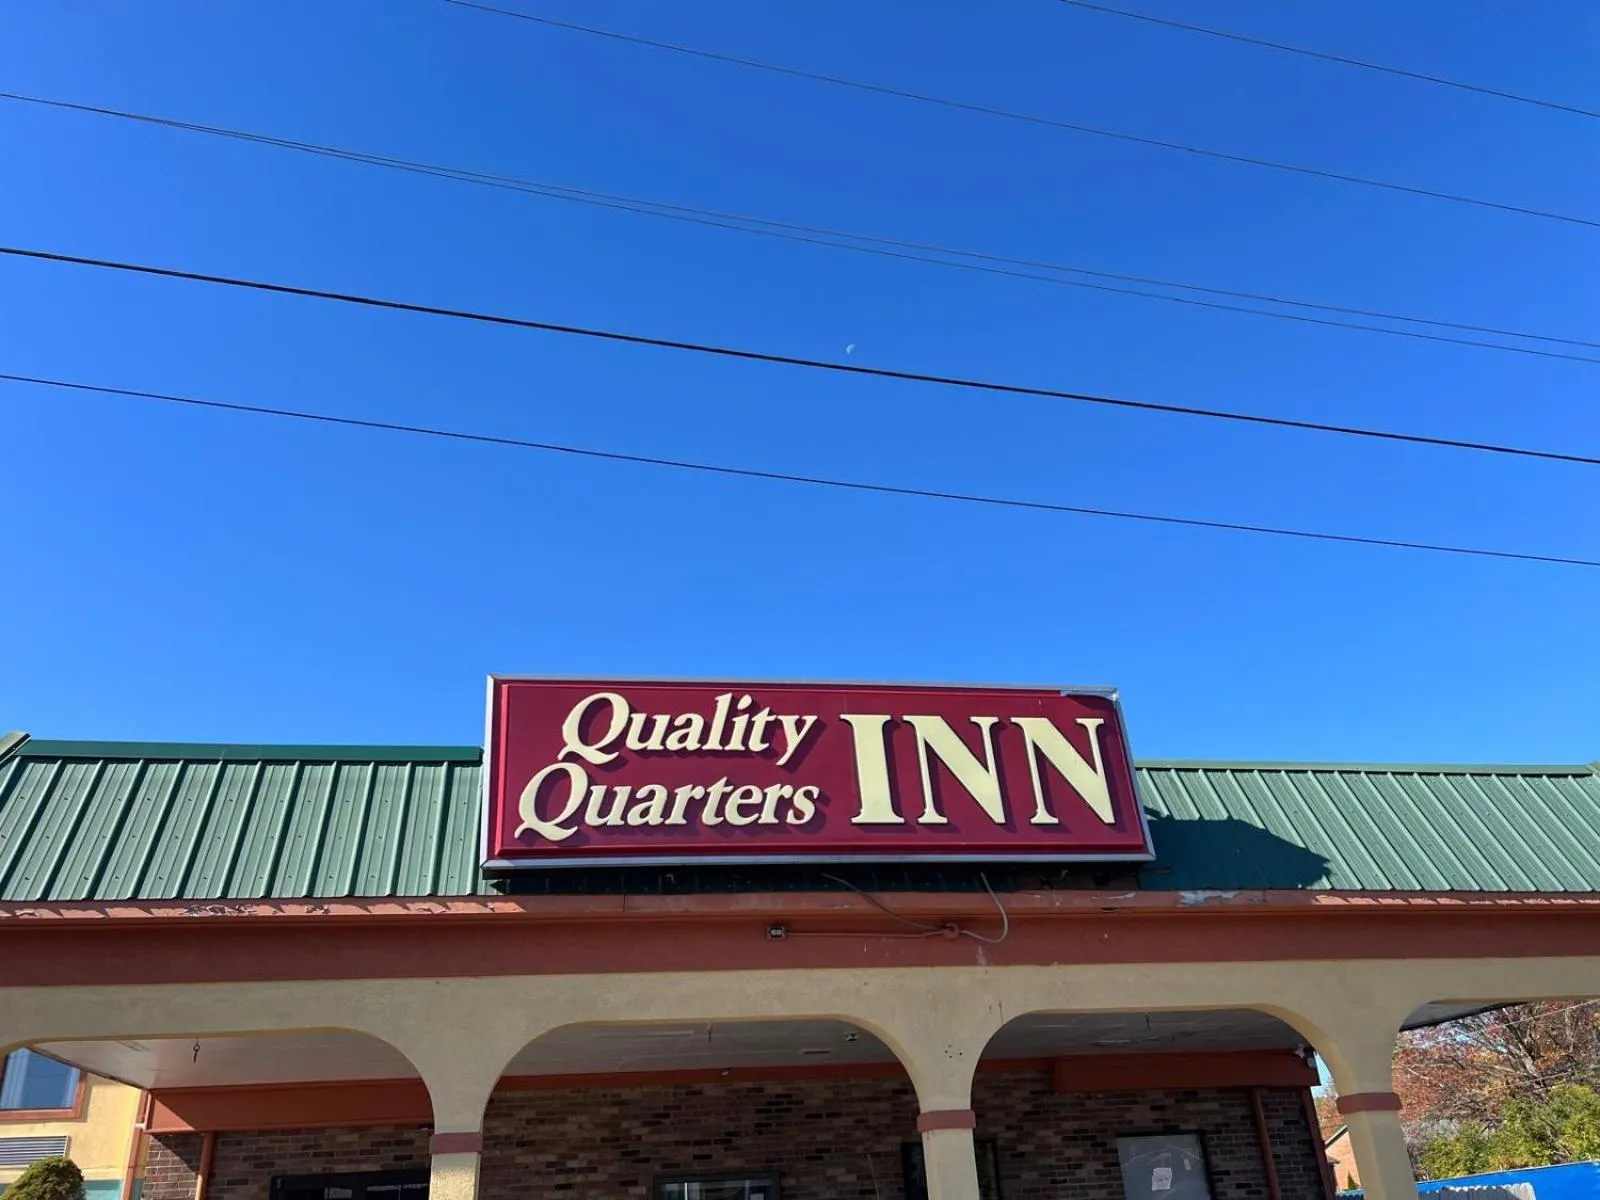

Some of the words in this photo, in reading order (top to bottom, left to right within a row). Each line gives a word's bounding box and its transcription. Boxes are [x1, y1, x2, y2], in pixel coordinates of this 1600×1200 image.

[557, 692, 818, 767] Quality
[839, 713, 1116, 825] INN
[513, 762, 820, 841] Quarters
